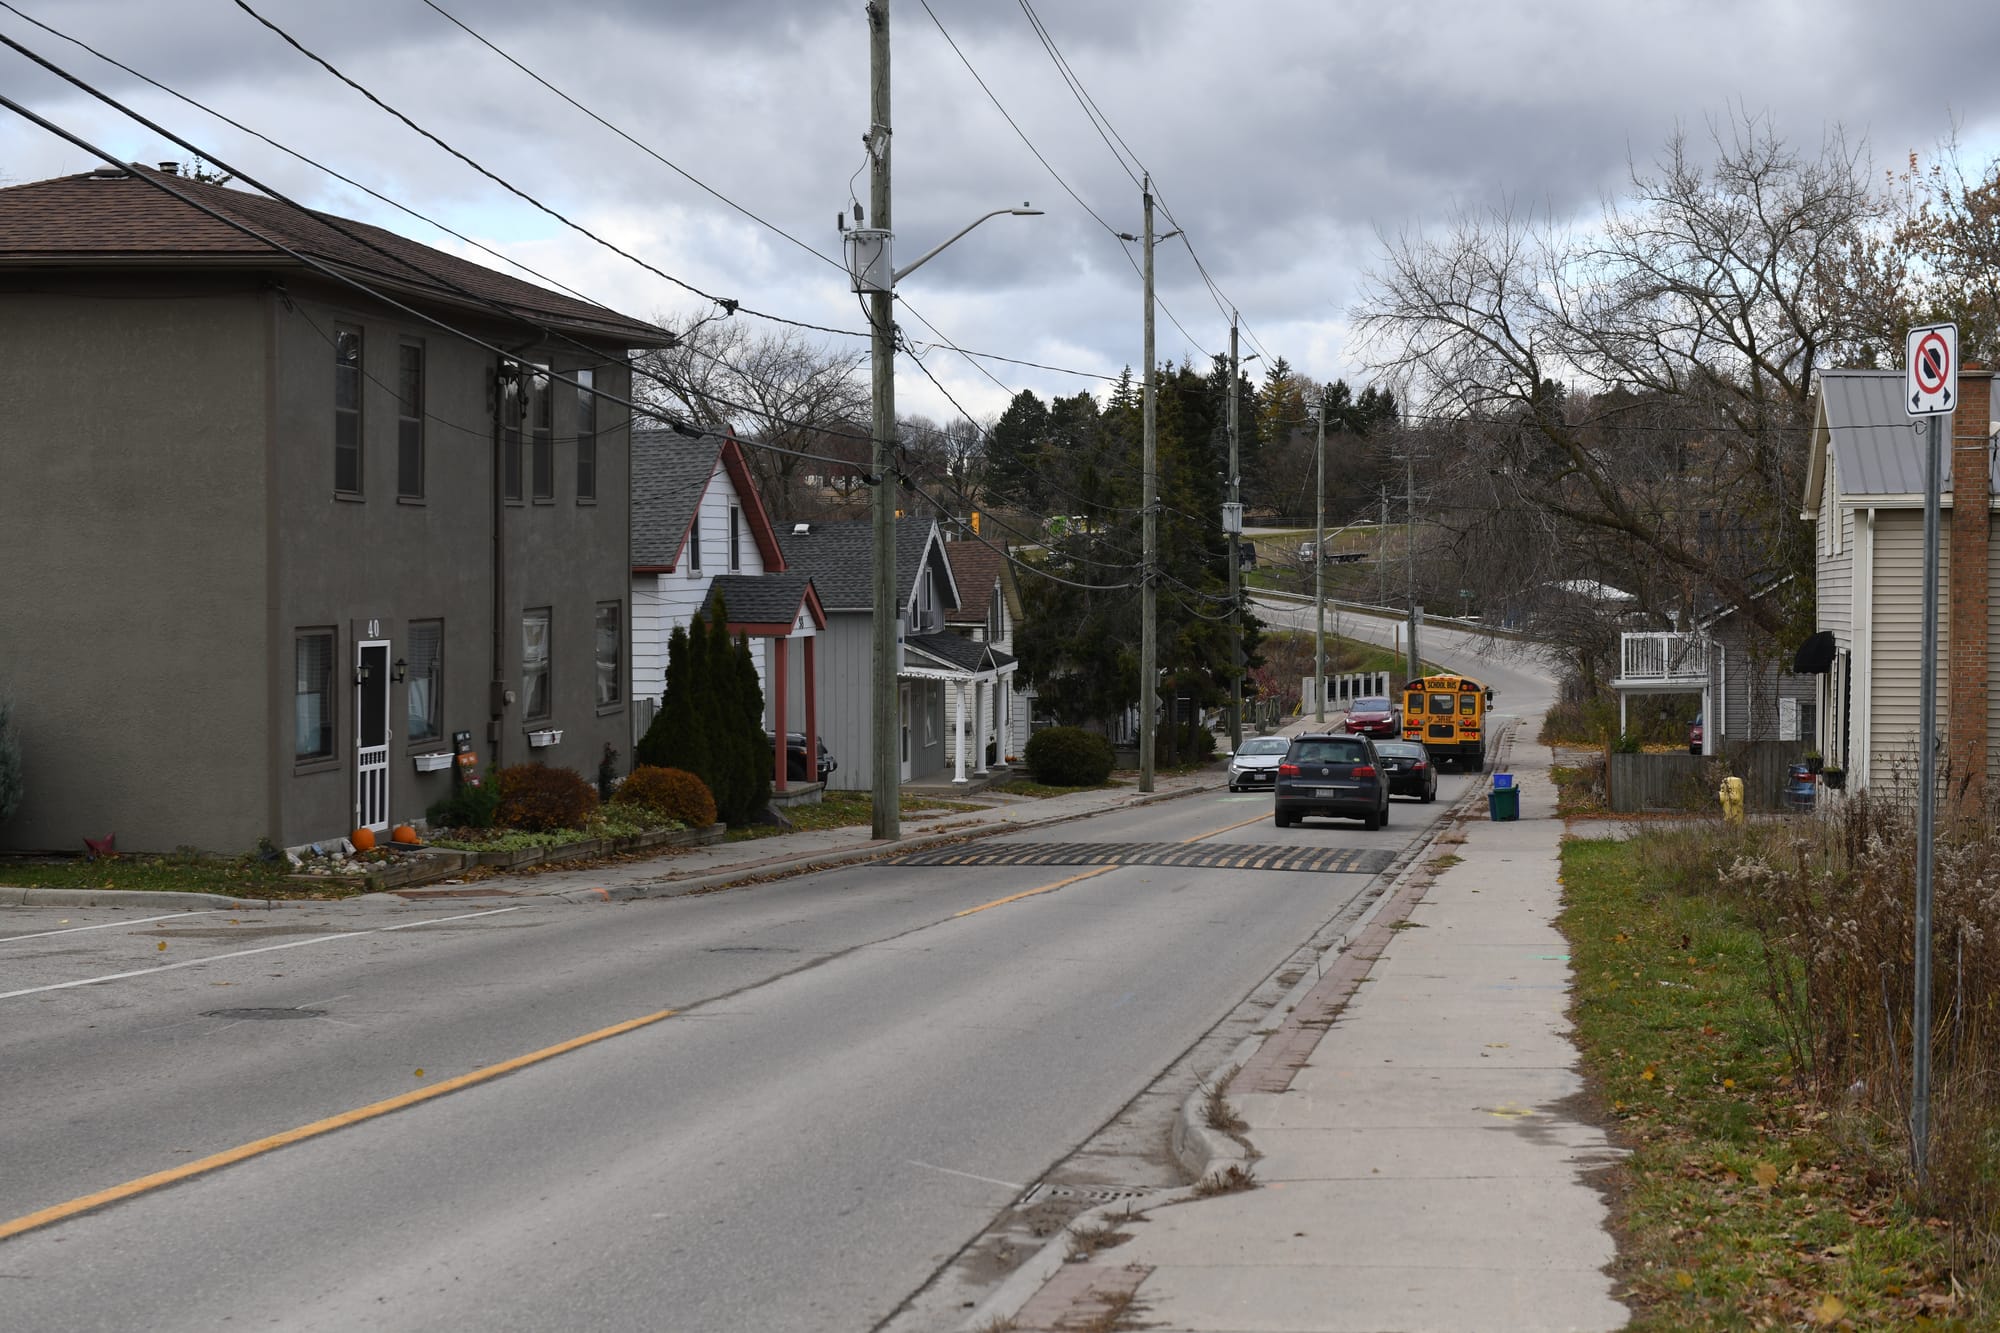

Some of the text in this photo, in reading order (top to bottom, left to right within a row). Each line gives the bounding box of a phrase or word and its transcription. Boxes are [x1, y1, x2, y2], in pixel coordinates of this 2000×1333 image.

[367, 619, 379, 638] 40
[1428, 681, 1457, 689] SCHOOL BUS
